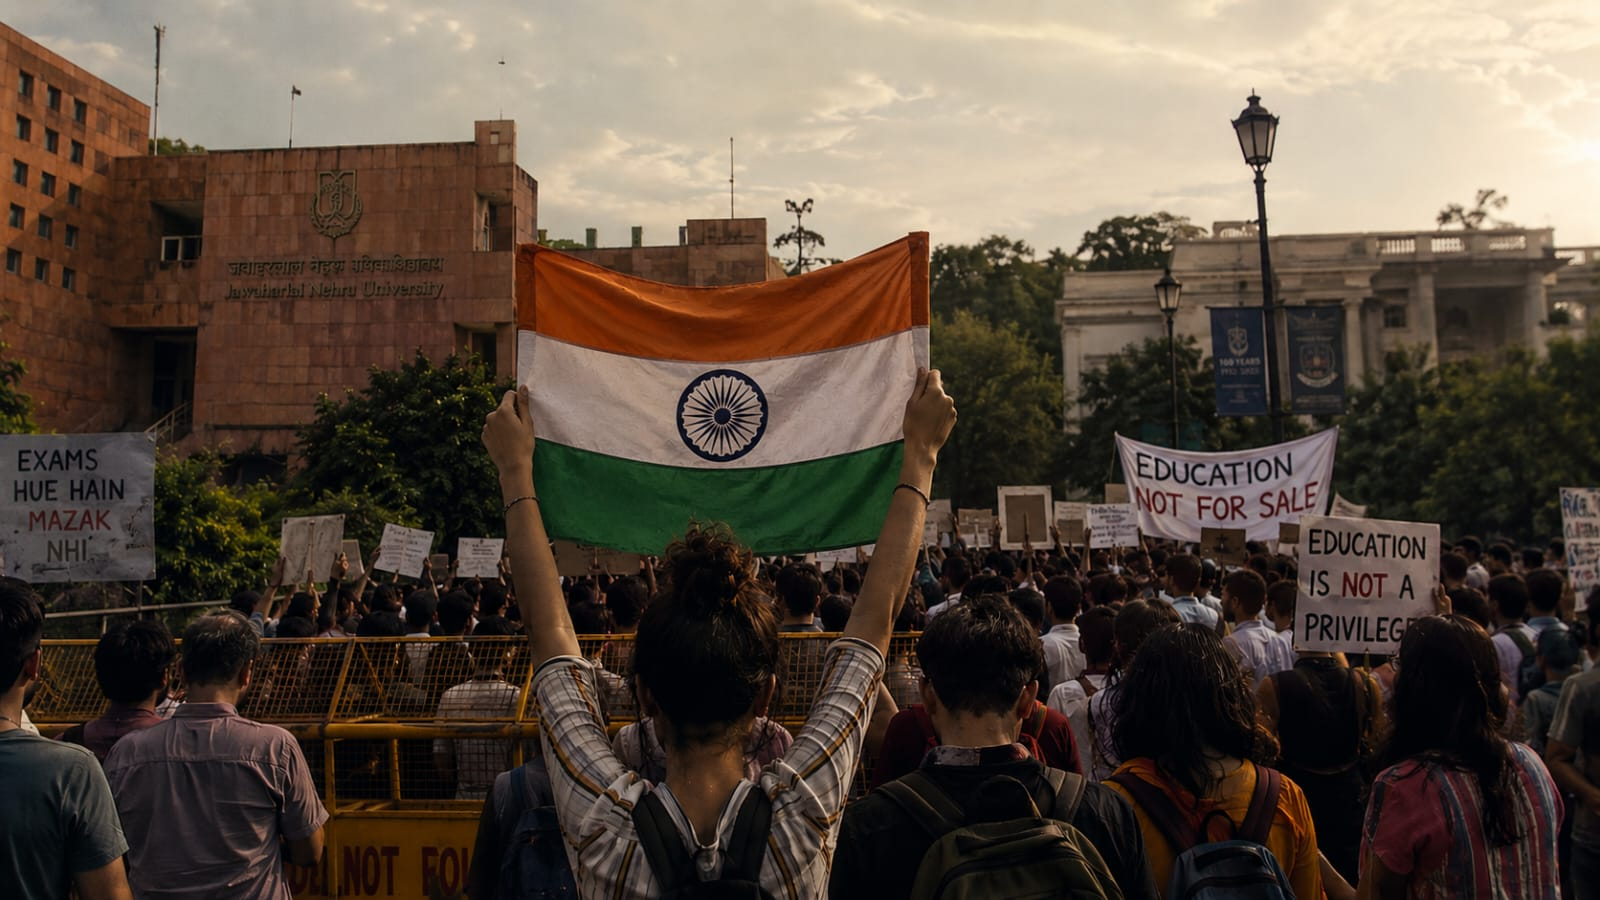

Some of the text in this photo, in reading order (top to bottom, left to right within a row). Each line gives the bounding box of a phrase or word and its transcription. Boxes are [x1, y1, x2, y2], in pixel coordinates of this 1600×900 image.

[309, 282, 356, 298] Nehru
[363, 281, 444, 299] University
[18, 448, 98, 472] EXAMS
[1136, 452, 1292, 486] EDUCATION
[14, 479, 124, 502] HUE HAIN
[1135, 486, 1183, 517] NOT
[1197, 495, 1247, 521] FOR
[1259, 481, 1319, 519] SALE
[28, 509, 112, 532] MAZAK
[47, 539, 87, 562] NHI
[1308, 528, 1426, 560] EDUCATION
[1309, 570, 1415, 600] IS NOT A
[343, 846, 400, 897] NOT
